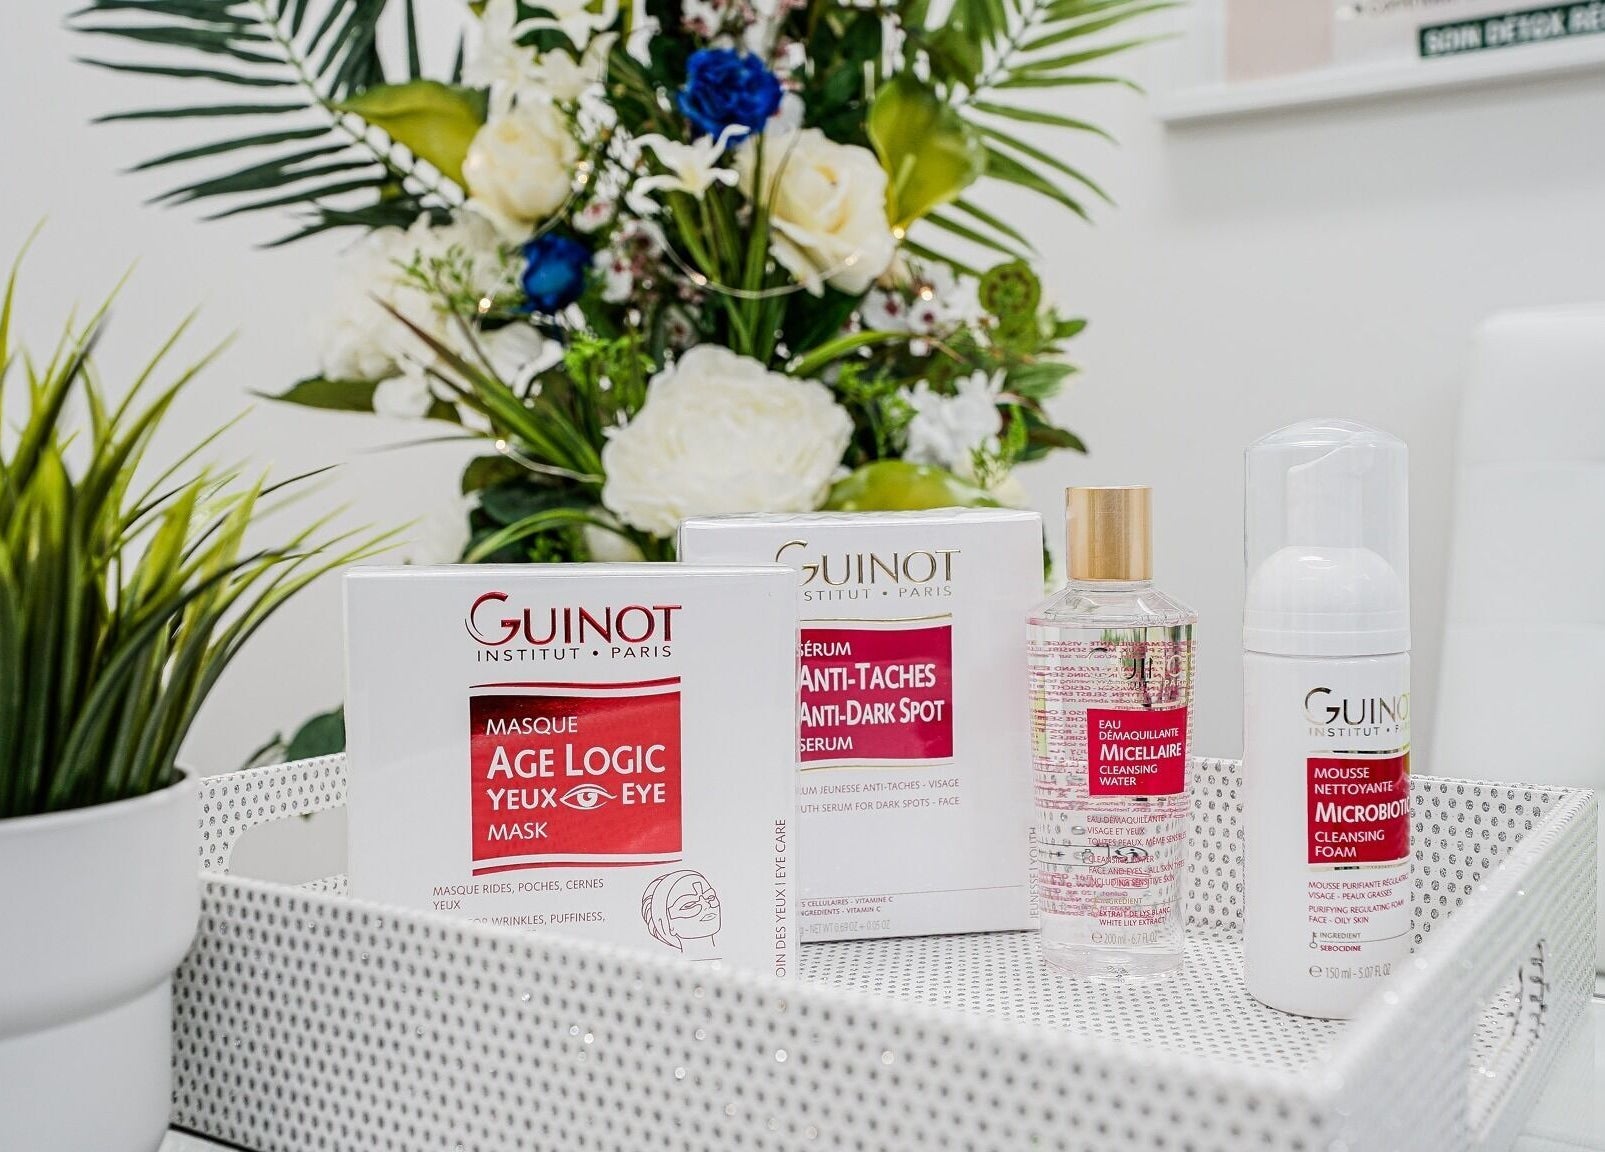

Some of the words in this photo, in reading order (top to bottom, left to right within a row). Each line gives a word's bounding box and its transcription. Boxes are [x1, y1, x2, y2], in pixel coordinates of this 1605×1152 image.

[804, 588, 871, 602] STITUT
[899, 586, 952, 598] PARIS
[464, 591, 682, 646] GUINOT
[477, 648, 580, 662] INSTITUT
[611, 645, 672, 659] PARIS
[899, 697, 945, 723] SPOT
[1304, 686, 1409, 726] GUINO
[486, 716, 578, 736] MASQUE
[1098, 719, 1121, 730] EAU
[1098, 727, 1180, 741] DÉMAQUILLANTE
[1308, 726, 1381, 738] INSTITUT
[1099, 742, 1182, 762] MICELLAIRE
[486, 745, 555, 780] AGE
[565, 743, 666, 777] LOGIC
[1099, 764, 1158, 776] CLEANSING
[1313, 767, 1370, 779] MOUSSE
[820, 784, 861, 795] JEUNESSE
[863, 780, 920, 793] ANTI-TACHES
[929, 778, 960, 789] VISAGE
[1099, 776, 1137, 787] WATER
[1314, 780, 1393, 796] NETTOYANTE
[486, 788, 558, 811] YEUX
[622, 782, 666, 805] EYE
[822, 802, 853, 813] SERUM
[855, 801, 873, 811] FOR
[876, 800, 900, 810] DARK
[903, 798, 930, 808] SPOTS
[938, 796, 960, 806] FACE
[487, 822, 548, 842] MASK
[775, 819, 787, 853] CARE
[1087, 827, 1113, 836] VISAGE
[1115, 828, 1124, 836] ET
[1125, 827, 1146, 836] YEUX
[1314, 829, 1385, 844] CLEANSING
[1315, 845, 1358, 858] FOAM
[775, 856, 787, 878] EYE
[432, 884, 480, 897] MASQUE
[482, 882, 516, 896] RIDES,
[518, 880, 563, 893] POCHES,
[565, 877, 605, 891] CERNES
[1308, 881, 1341, 890] MOUSSE
[1342, 880, 1381, 890] PURIFIANTE
[855, 896, 887, 904] VITAMINE
[1308, 892, 1335, 900] VISAGE
[1342, 892, 1366, 900] PEAUX
[1367, 888, 1393, 899] GRASSES
[432, 899, 462, 912] YEUX
[775, 889, 787, 923] YEUX
[800, 908, 840, 917] NGREDIENTS
[846, 906, 874, 914] VITAMIN
[1308, 905, 1349, 914] PURIFYING
[1350, 902, 1391, 914] REGULATING
[549, 911, 606, 925] PUFFINESS,
[1099, 919, 1122, 927] WHITE
[1123, 919, 1137, 927] LILY
[1308, 916, 1327, 924] FACE
[1334, 916, 1351, 925] OILY
[1353, 916, 1369, 924] SKIN
[775, 926, 787, 950] DES
[1319, 932, 1362, 940] INGREDIENT
[1319, 944, 1362, 952] SEBOCIDINE
[775, 954, 787, 978] OIN
[1325, 966, 1340, 979] 150
